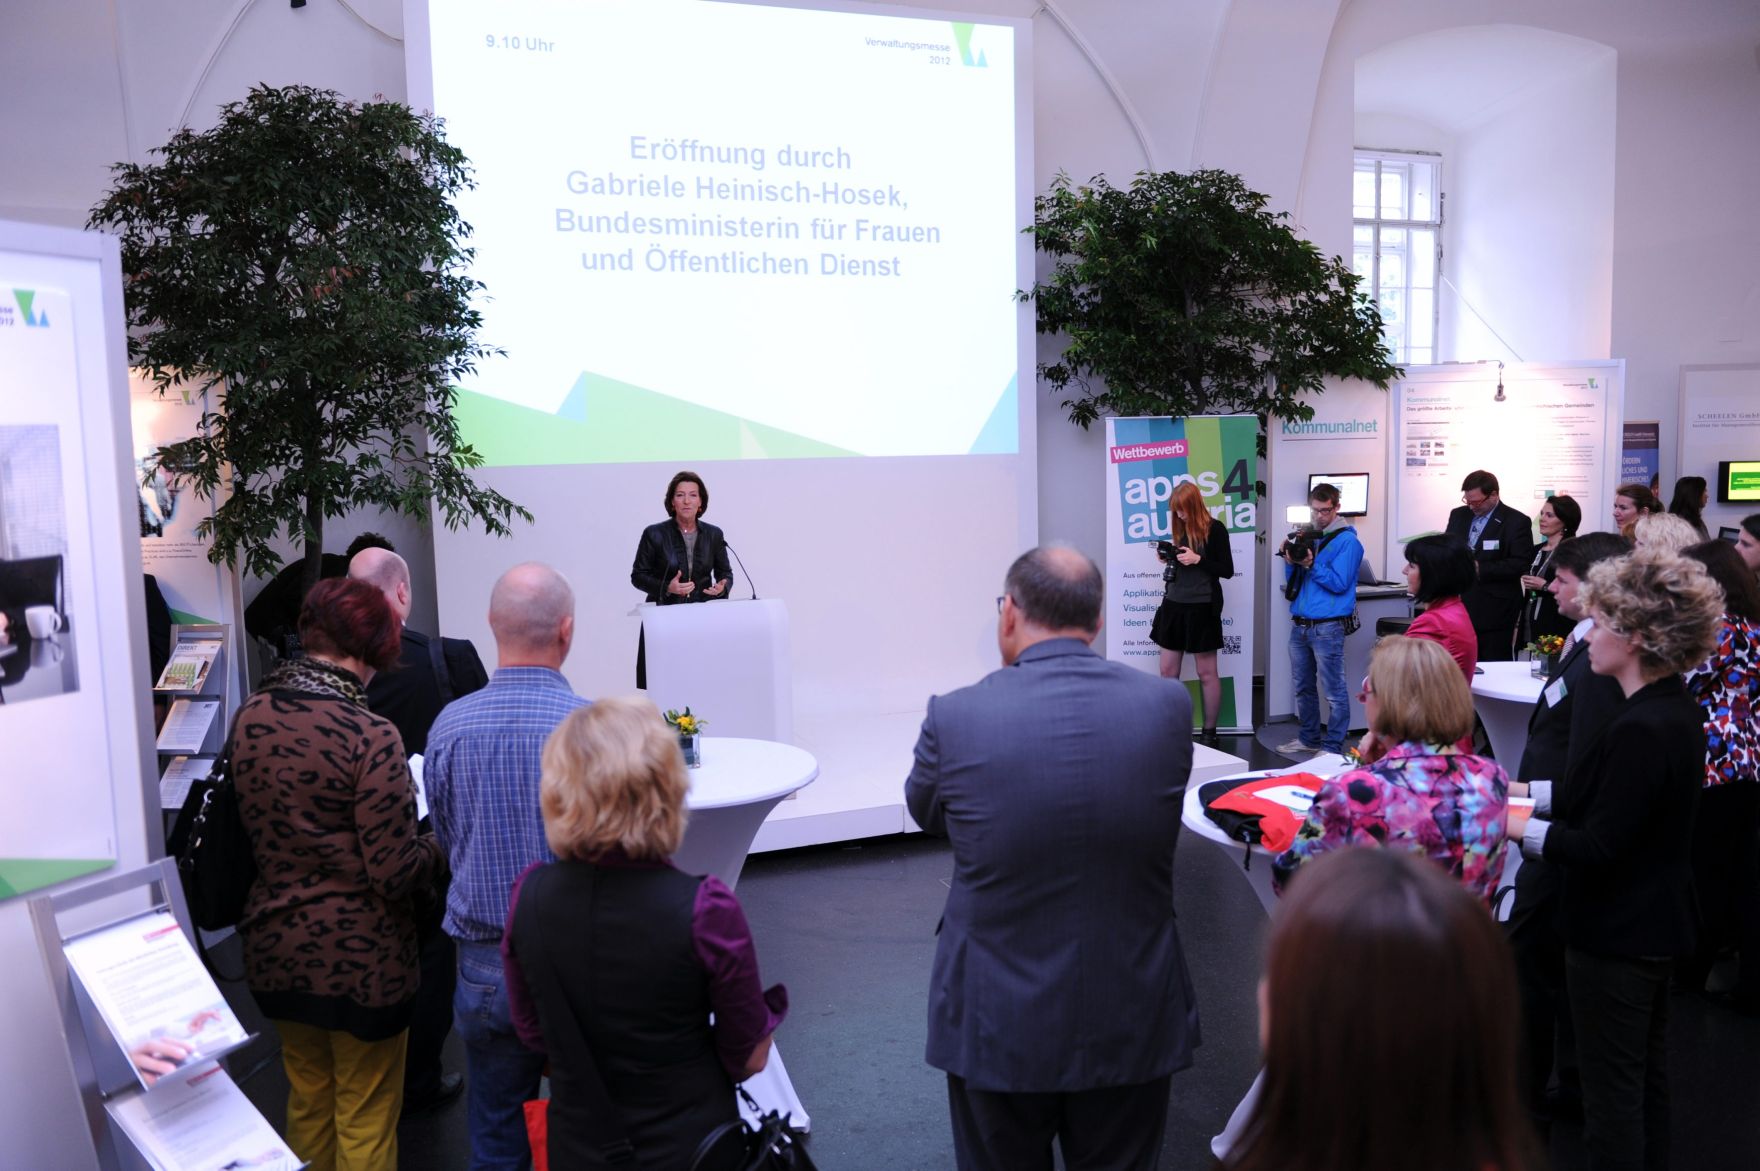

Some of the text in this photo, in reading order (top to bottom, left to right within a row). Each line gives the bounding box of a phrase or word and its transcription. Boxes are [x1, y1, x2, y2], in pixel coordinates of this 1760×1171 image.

[485, 34, 555, 52] 9.10 Uhr
[865, 37, 951, 52] Verwaltungsmesse
[929, 55, 951, 65] 2012
[629, 136, 852, 171] Eröffnung durch
[566, 170, 909, 209] Gabriele Heinisch-Hosek,
[555, 208, 940, 244] Bundesministerin für Frauen
[582, 243, 901, 277] und Öffentlichen Dienst
[1282, 419, 1378, 434] Kommunalnet
[1113, 443, 1185, 460] Wettbewerb
[1128, 496, 1256, 538] auria
[1123, 589, 1166, 598] Applikatio
[1123, 604, 1159, 612] Visualisi
[1123, 619, 1147, 627] Ideen
